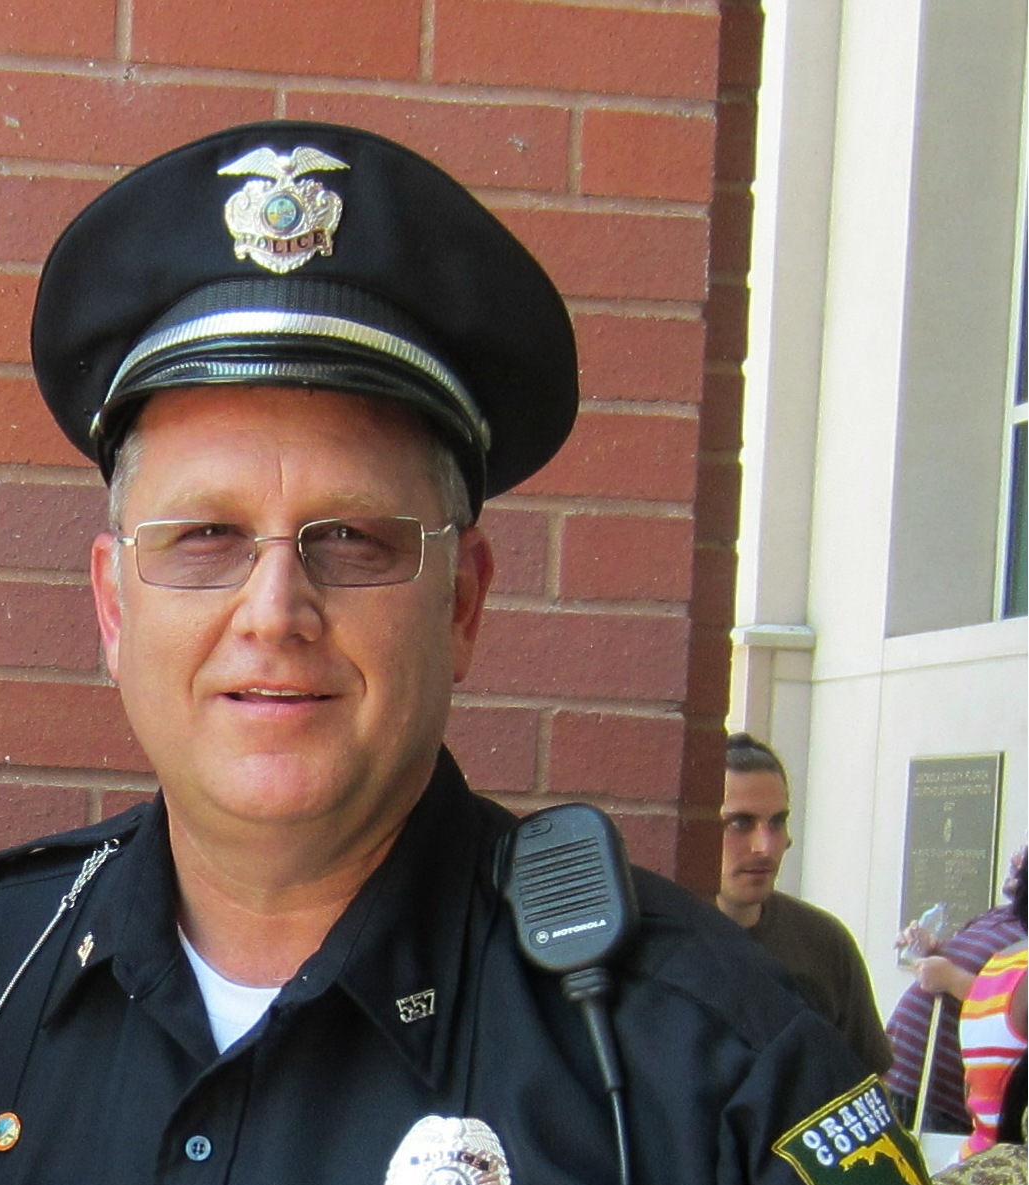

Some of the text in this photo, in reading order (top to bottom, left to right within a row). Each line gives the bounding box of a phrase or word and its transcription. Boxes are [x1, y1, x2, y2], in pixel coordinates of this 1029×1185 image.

[240, 231, 325, 253] POLICE
[552, 919, 607, 938] MOTOROLA
[396, 989, 435, 1023] 557
[802, 1088, 882, 1149] ORANGE
[816, 1105, 891, 1166] COUNTY
